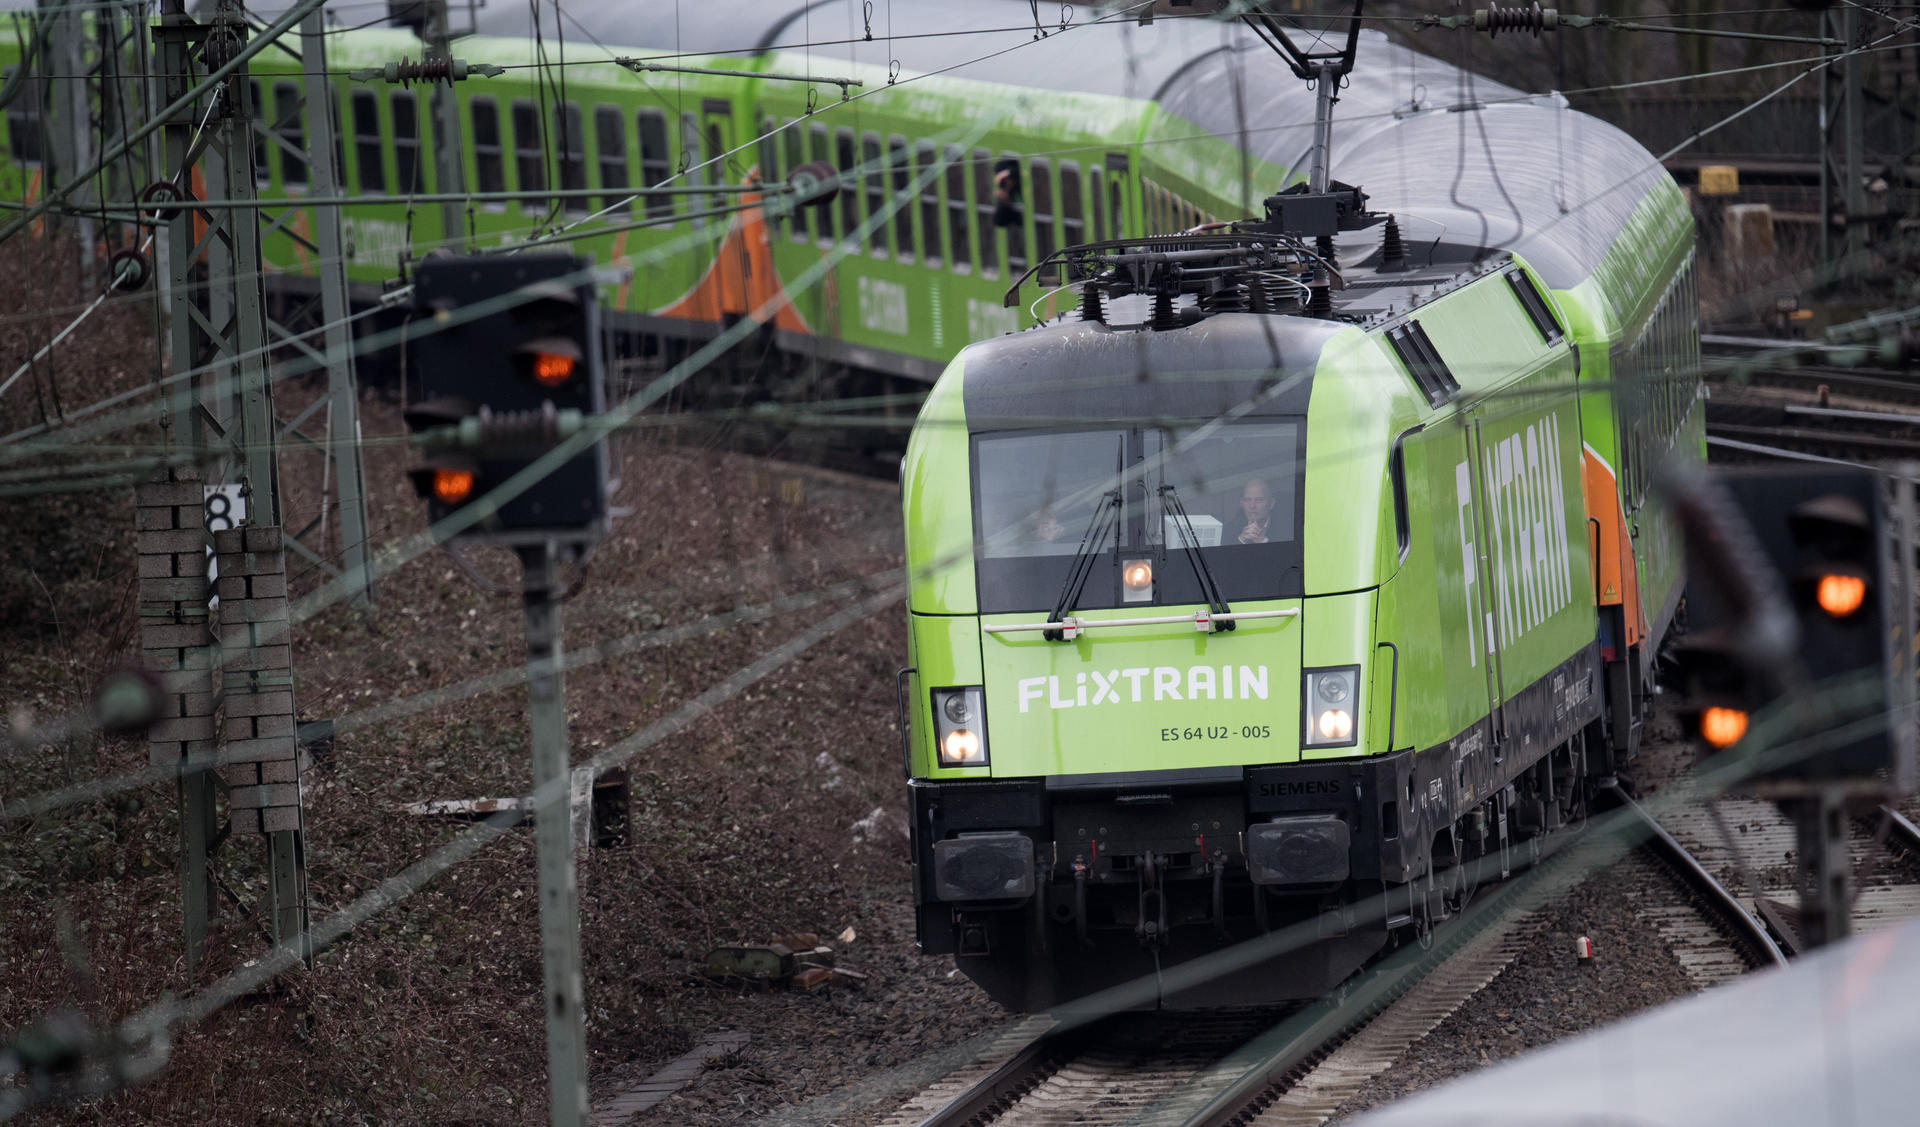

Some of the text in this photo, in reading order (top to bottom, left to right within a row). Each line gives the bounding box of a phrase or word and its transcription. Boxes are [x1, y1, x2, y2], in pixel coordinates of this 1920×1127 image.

[1161, 727, 1179, 741] ES
[1184, 727, 1203, 740] 64
[1207, 726, 1228, 739] U2
[1242, 725, 1270, 738] 005
[1260, 780, 1341, 796] SIEMENS
